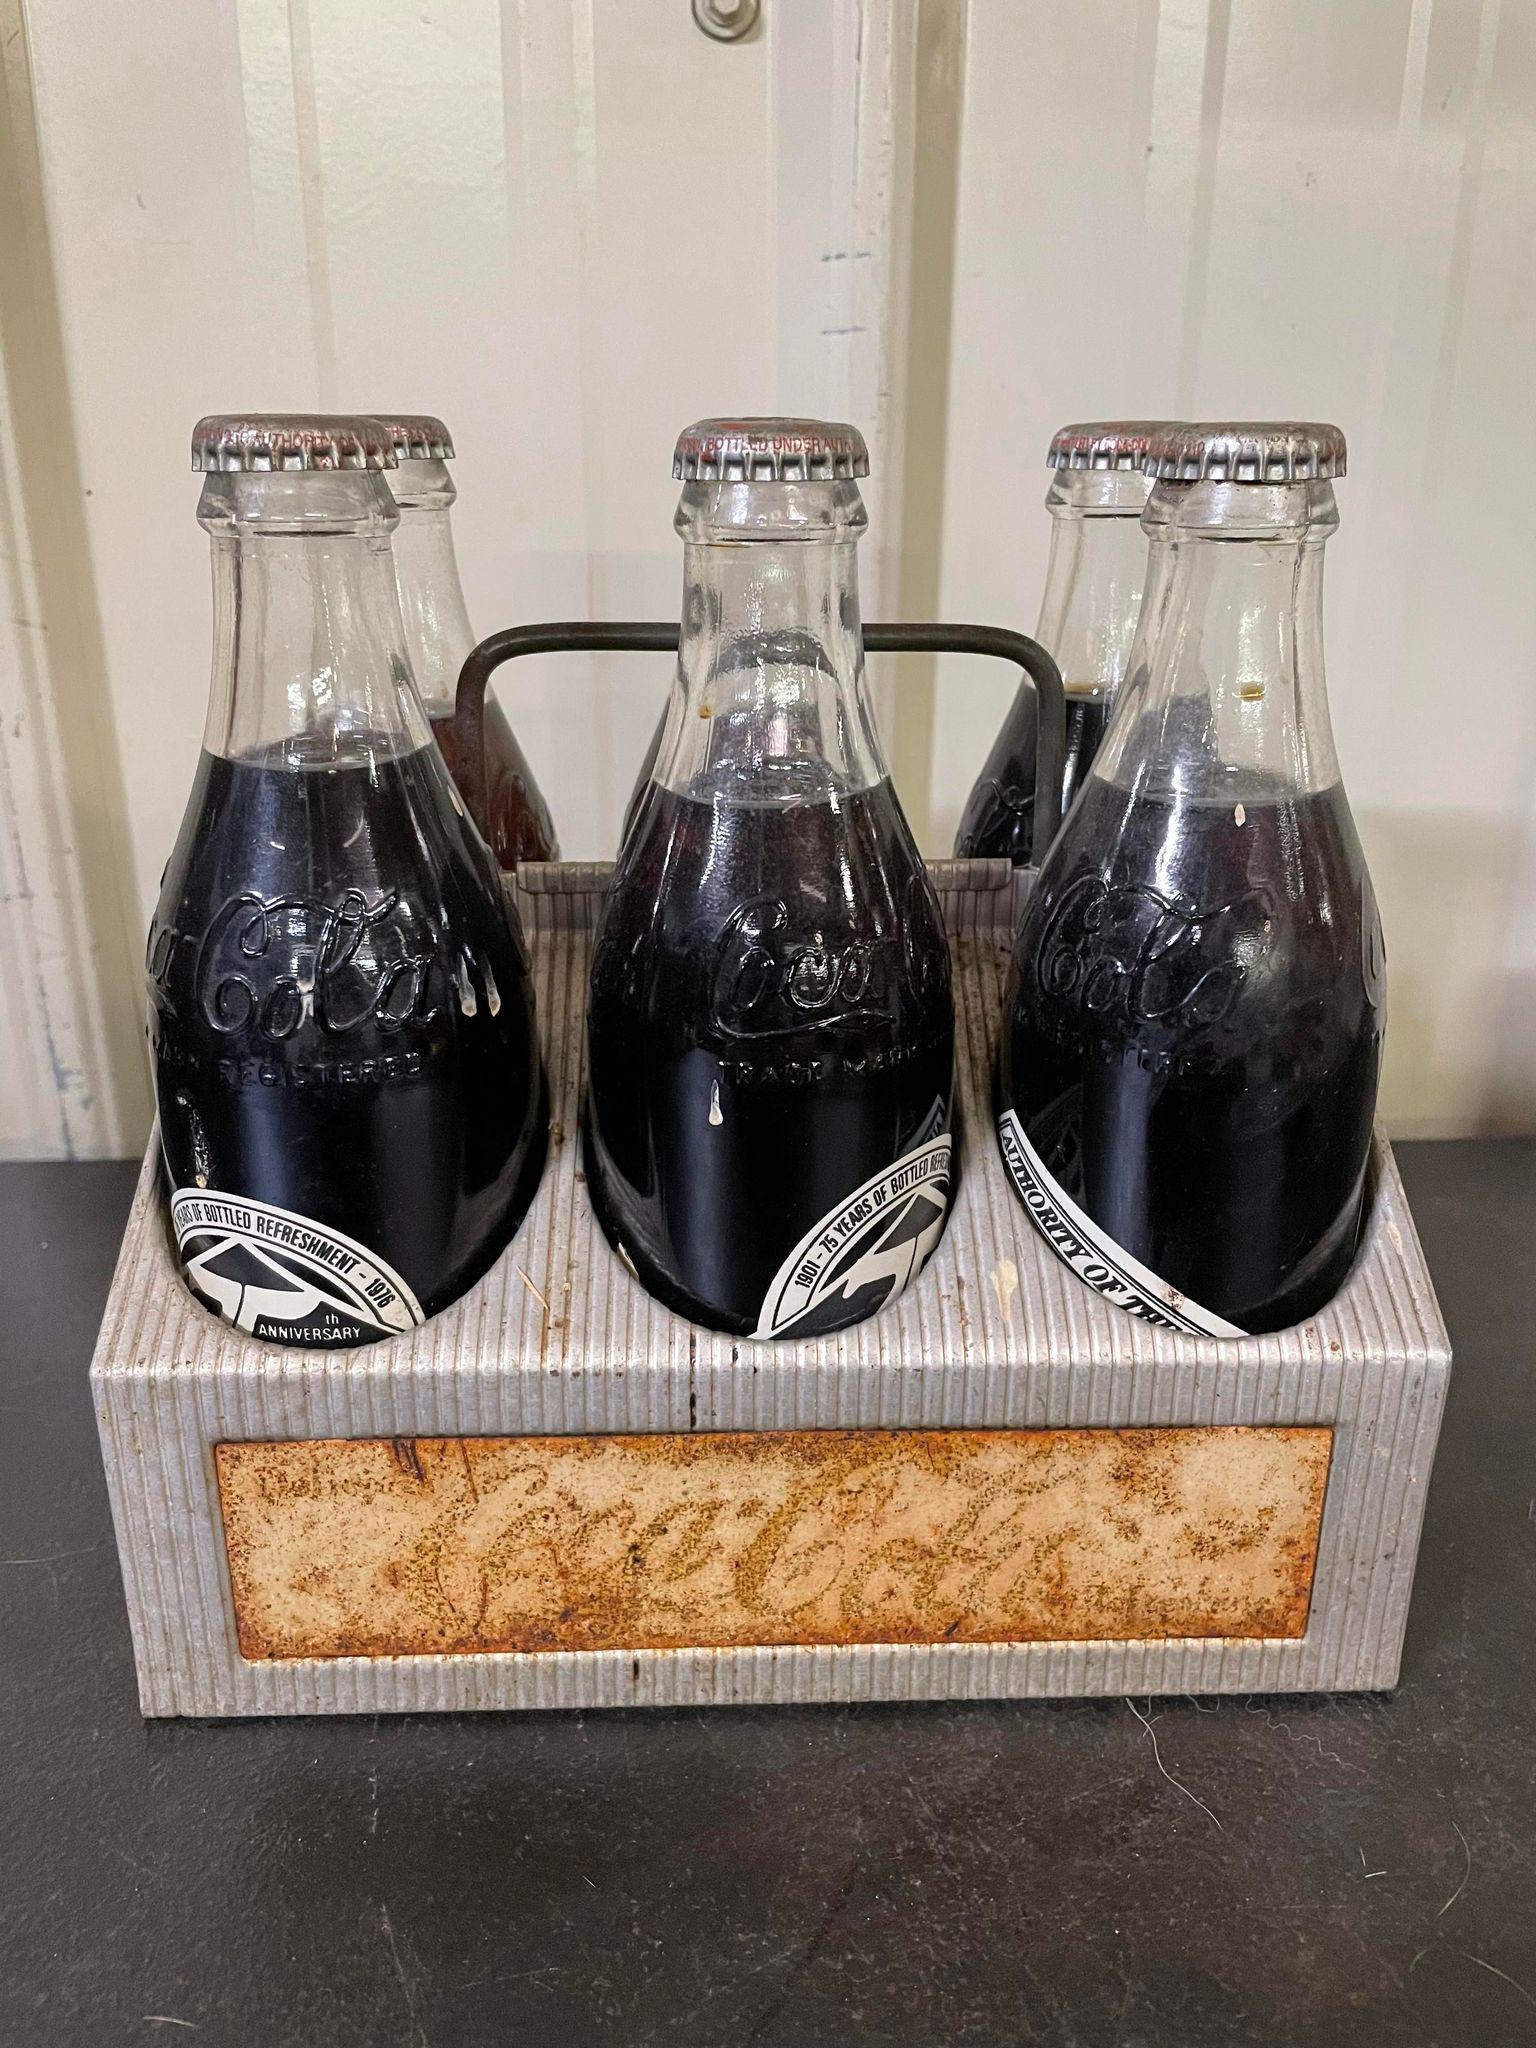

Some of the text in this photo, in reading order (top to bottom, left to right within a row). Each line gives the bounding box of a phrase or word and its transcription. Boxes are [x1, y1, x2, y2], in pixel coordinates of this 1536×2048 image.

[707, 435, 769, 452] BOTTLED
[772, 436, 821, 453] UNDER
[794, 1259, 822, 1289] 1901
[818, 1233, 839, 1254] 75
[832, 1197, 873, 1238] YEARS
[872, 1184, 888, 1207] OF
[890, 1157, 929, 1196] BOTTLED
[1001, 1134, 1094, 1261] AUTHORITY
[1083, 1263, 1129, 1295] OF
[191, 1202, 203, 1222] OF
[203, 1203, 251, 1230] BOTTLED
[256, 1215, 361, 1274] REFRESHMENT
[364, 1277, 396, 1309] 1976
[258, 1323, 361, 1341] ANNIVERSARY
[325, 1313, 339, 1325] th
